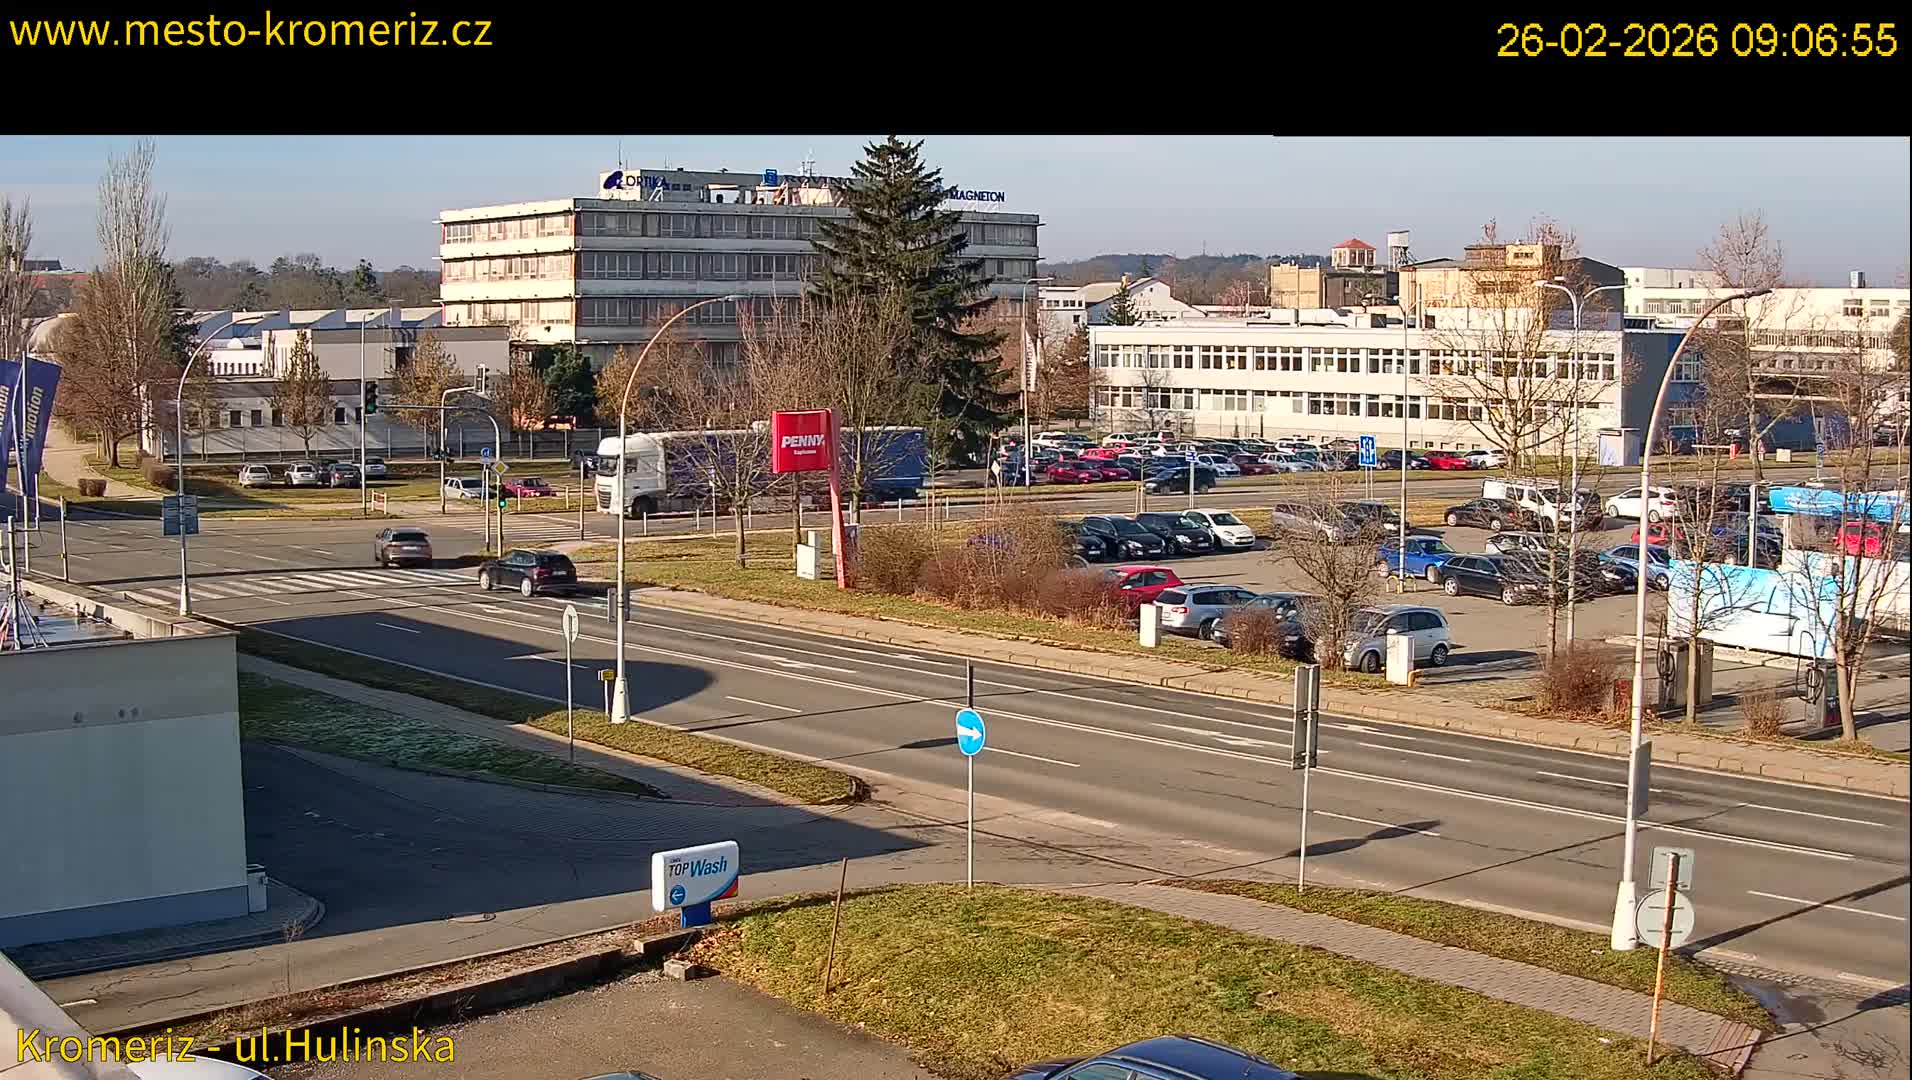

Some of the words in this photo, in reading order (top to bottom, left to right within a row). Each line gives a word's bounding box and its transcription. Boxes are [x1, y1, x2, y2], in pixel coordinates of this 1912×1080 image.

[951, 190, 1005, 202] MAGNETON
[669, 862, 689, 877] TOP
[690, 856, 727, 877] Wash
